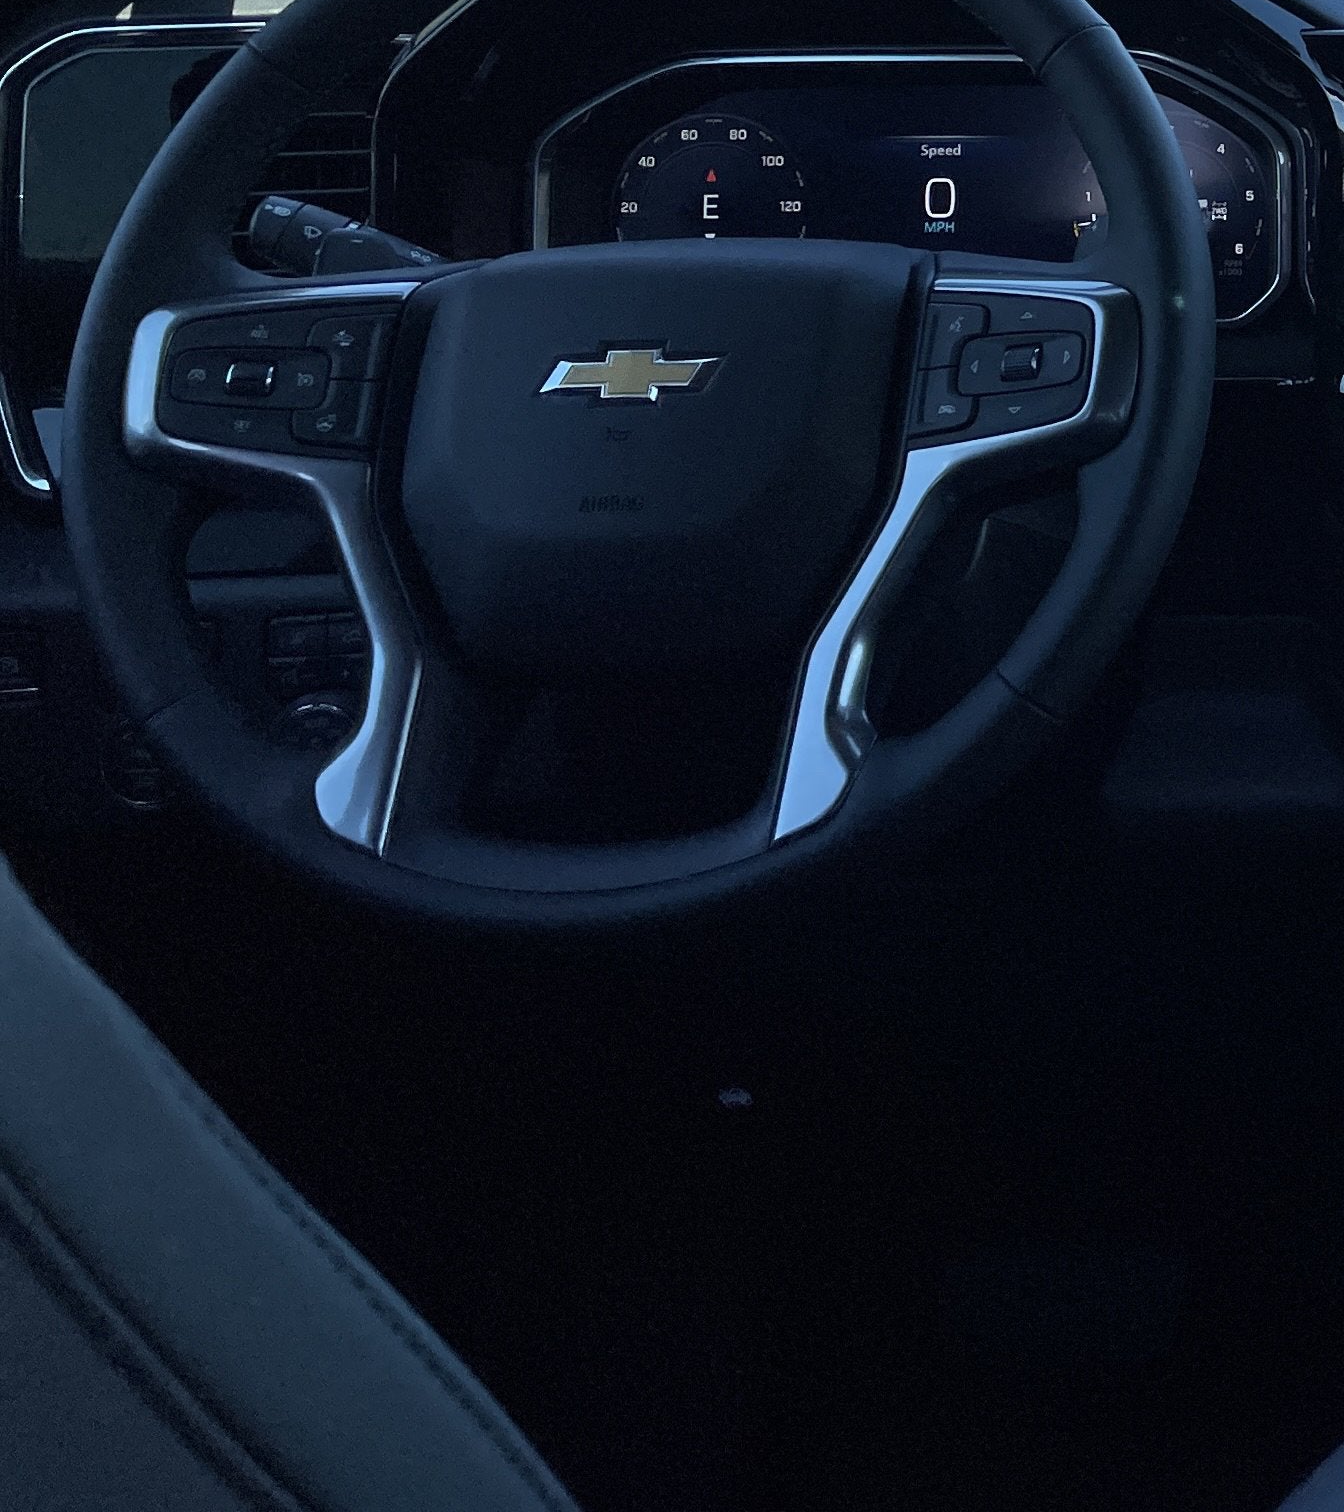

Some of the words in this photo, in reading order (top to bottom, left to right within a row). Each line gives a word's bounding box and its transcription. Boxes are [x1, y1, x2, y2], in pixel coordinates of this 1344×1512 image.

[680, 129, 698, 141] 60
[729, 128, 747, 141] 80
[920, 143, 962, 159] Speed
[1216, 143, 1225, 154] 4
[637, 156, 655, 168] 40
[760, 155, 785, 167] 100
[924, 177, 956, 219] 0
[1085, 191, 1091, 202] 1
[1245, 190, 1255, 202] 5
[620, 201, 638, 213] 20
[702, 194, 720, 220] E
[779, 200, 802, 212] 120
[924, 221, 955, 233] MPH
[1234, 243, 1244, 255] 6
